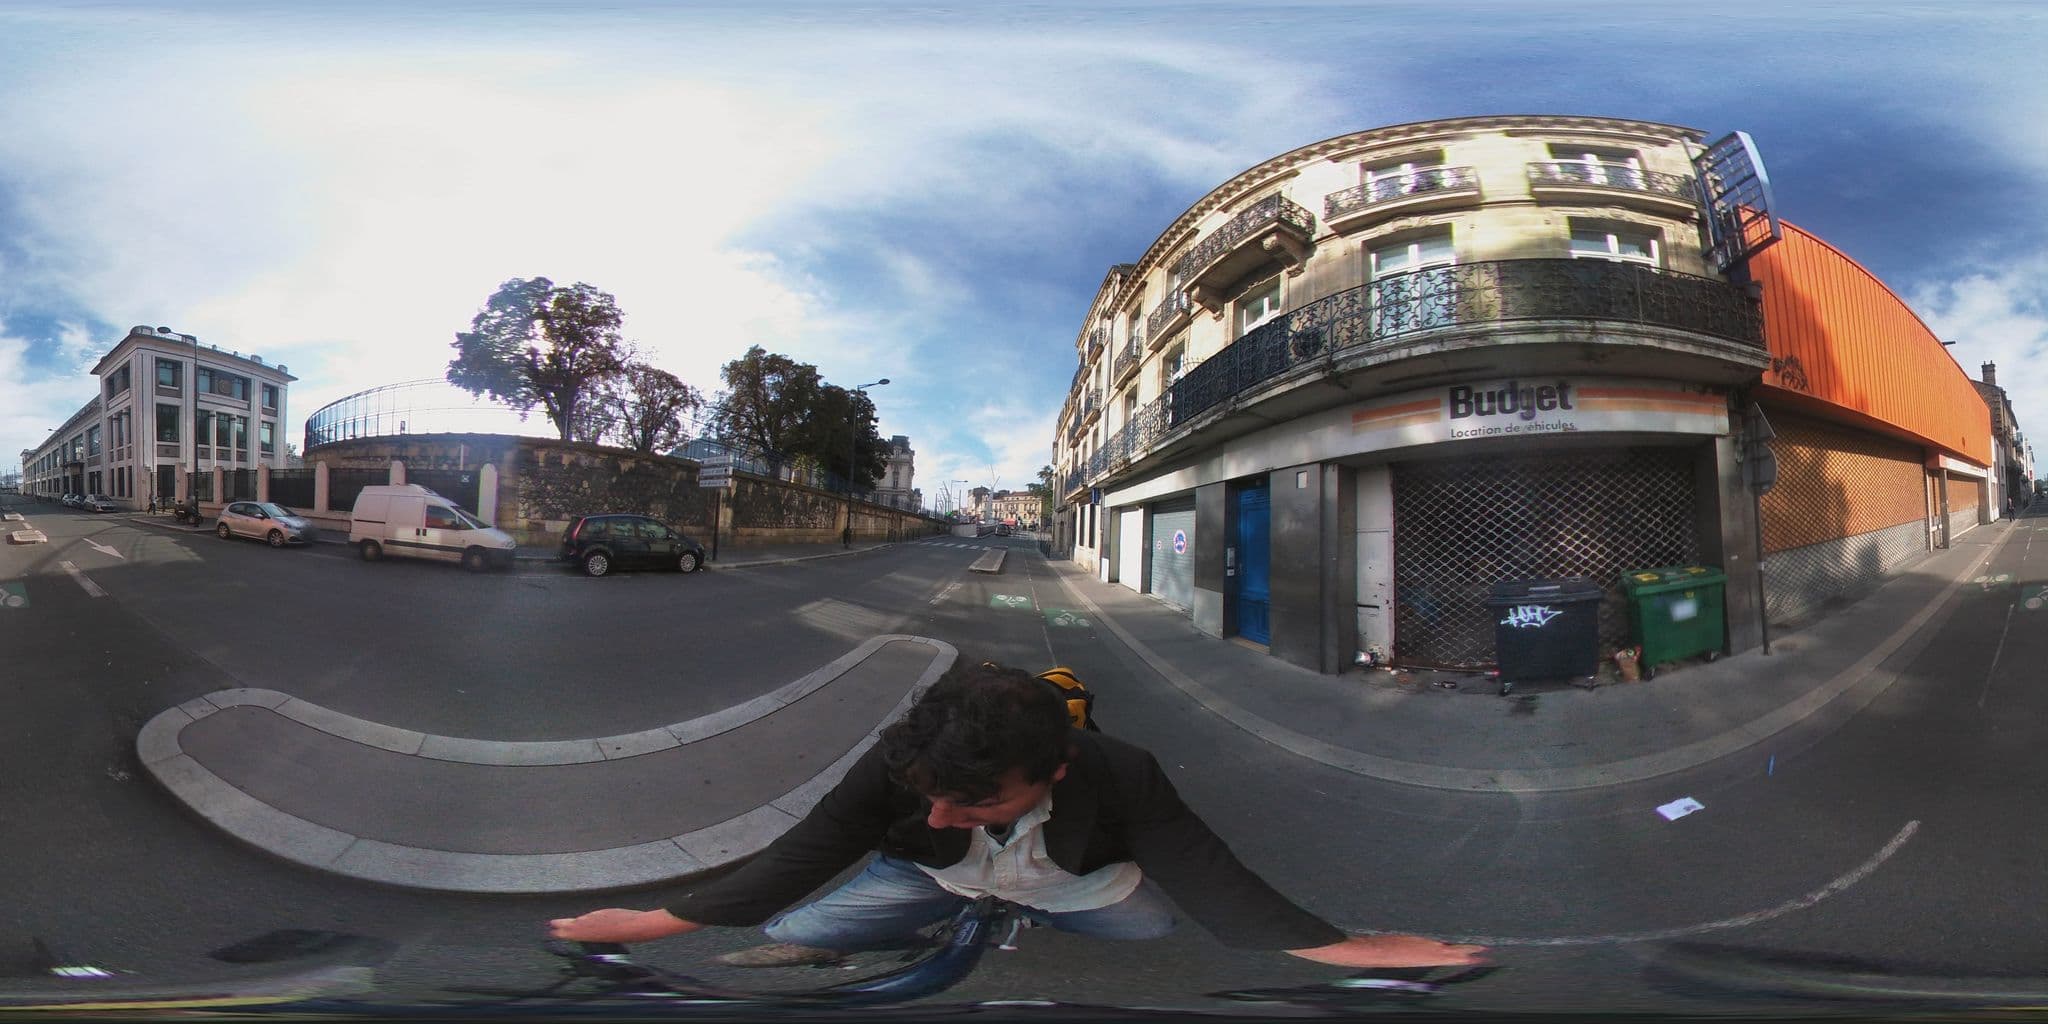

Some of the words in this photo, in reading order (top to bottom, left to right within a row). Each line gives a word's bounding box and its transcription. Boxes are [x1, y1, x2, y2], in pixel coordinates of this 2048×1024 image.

[1449, 380, 1573, 420] Budget
[1450, 426, 1502, 438] Location
[1504, 422, 1520, 433] de
